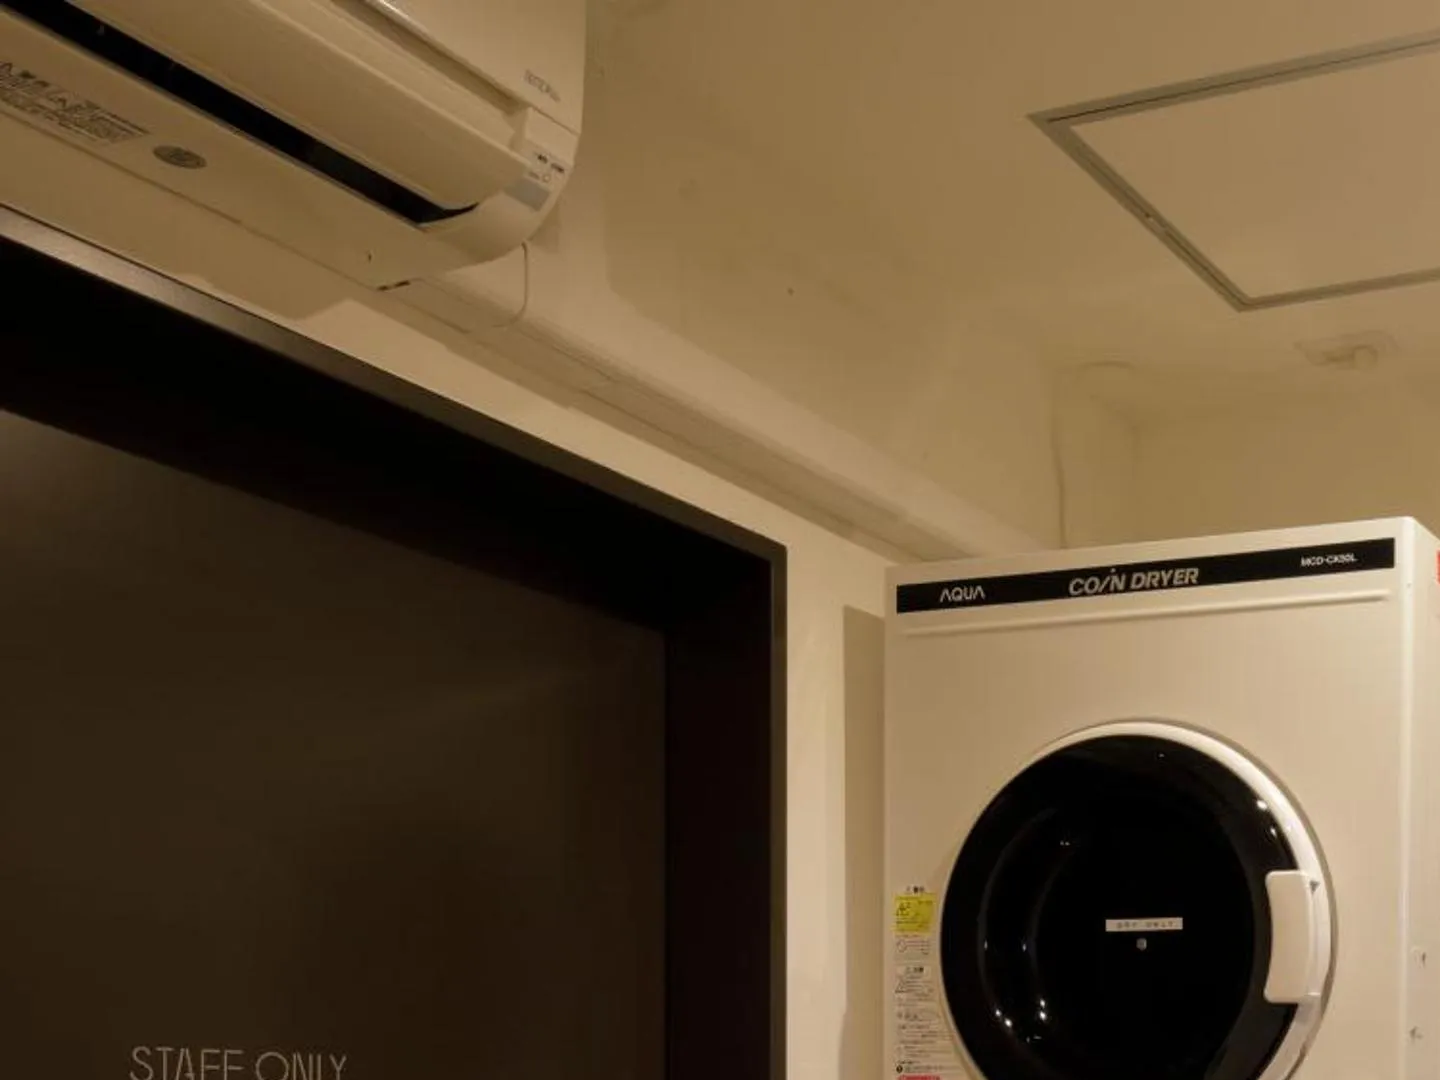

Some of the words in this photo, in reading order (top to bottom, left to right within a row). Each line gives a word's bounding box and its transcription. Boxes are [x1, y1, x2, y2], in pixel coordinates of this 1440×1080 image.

[939, 586, 985, 602] AQUA
[1069, 568, 1126, 596] COIN
[1130, 568, 1199, 589] DRYER
